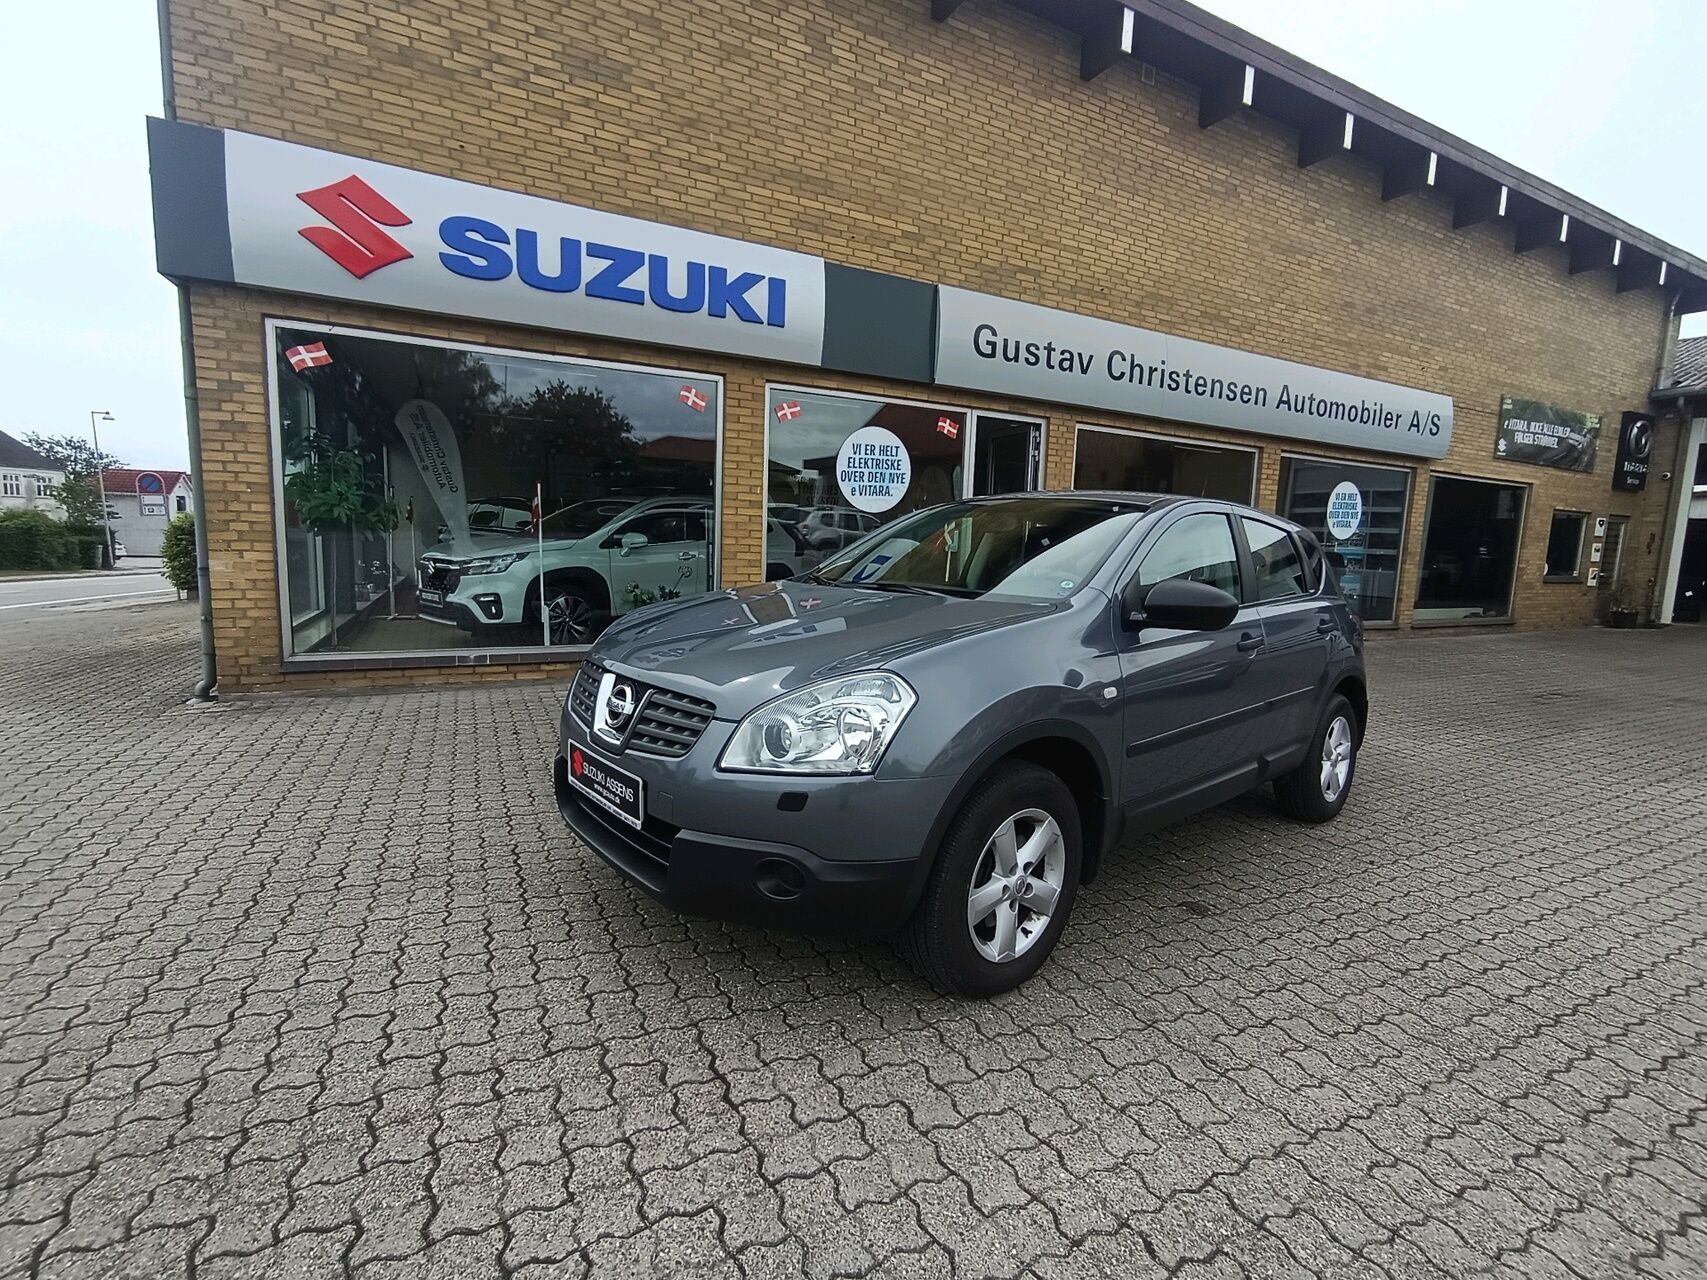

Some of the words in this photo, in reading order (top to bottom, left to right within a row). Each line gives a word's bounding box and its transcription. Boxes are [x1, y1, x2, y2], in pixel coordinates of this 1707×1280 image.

[438, 215, 786, 328] SUZUKI
[972, 323, 1094, 375] Gustav
[1107, 350, 1268, 408] Christensen
[1276, 384, 1402, 430] Automobiler
[1407, 410, 1441, 437] A/S
[852, 443, 861, 455] VI
[864, 444, 876, 456] ER
[879, 445, 900, 457] HELT
[847, 457, 902, 470] ELEKTRISKE
[841, 470, 865, 482] OVER
[868, 471, 886, 483] DEN
[888, 472, 906, 484] NYE
[851, 486, 856, 496] e
[858, 485, 893, 496] VITARA.
[1341, 493, 1347, 501] ER
[1348, 493, 1358, 501] HELT
[1332, 502, 1358, 510] ELEKTRISKE
[1329, 511, 1340, 519] OVER
[1341, 511, 1350, 519] DEN
[1351, 511, 1359, 520] NYE
[583, 761, 605, 786] SUZUKI
[606, 777, 634, 802] ASSENS
